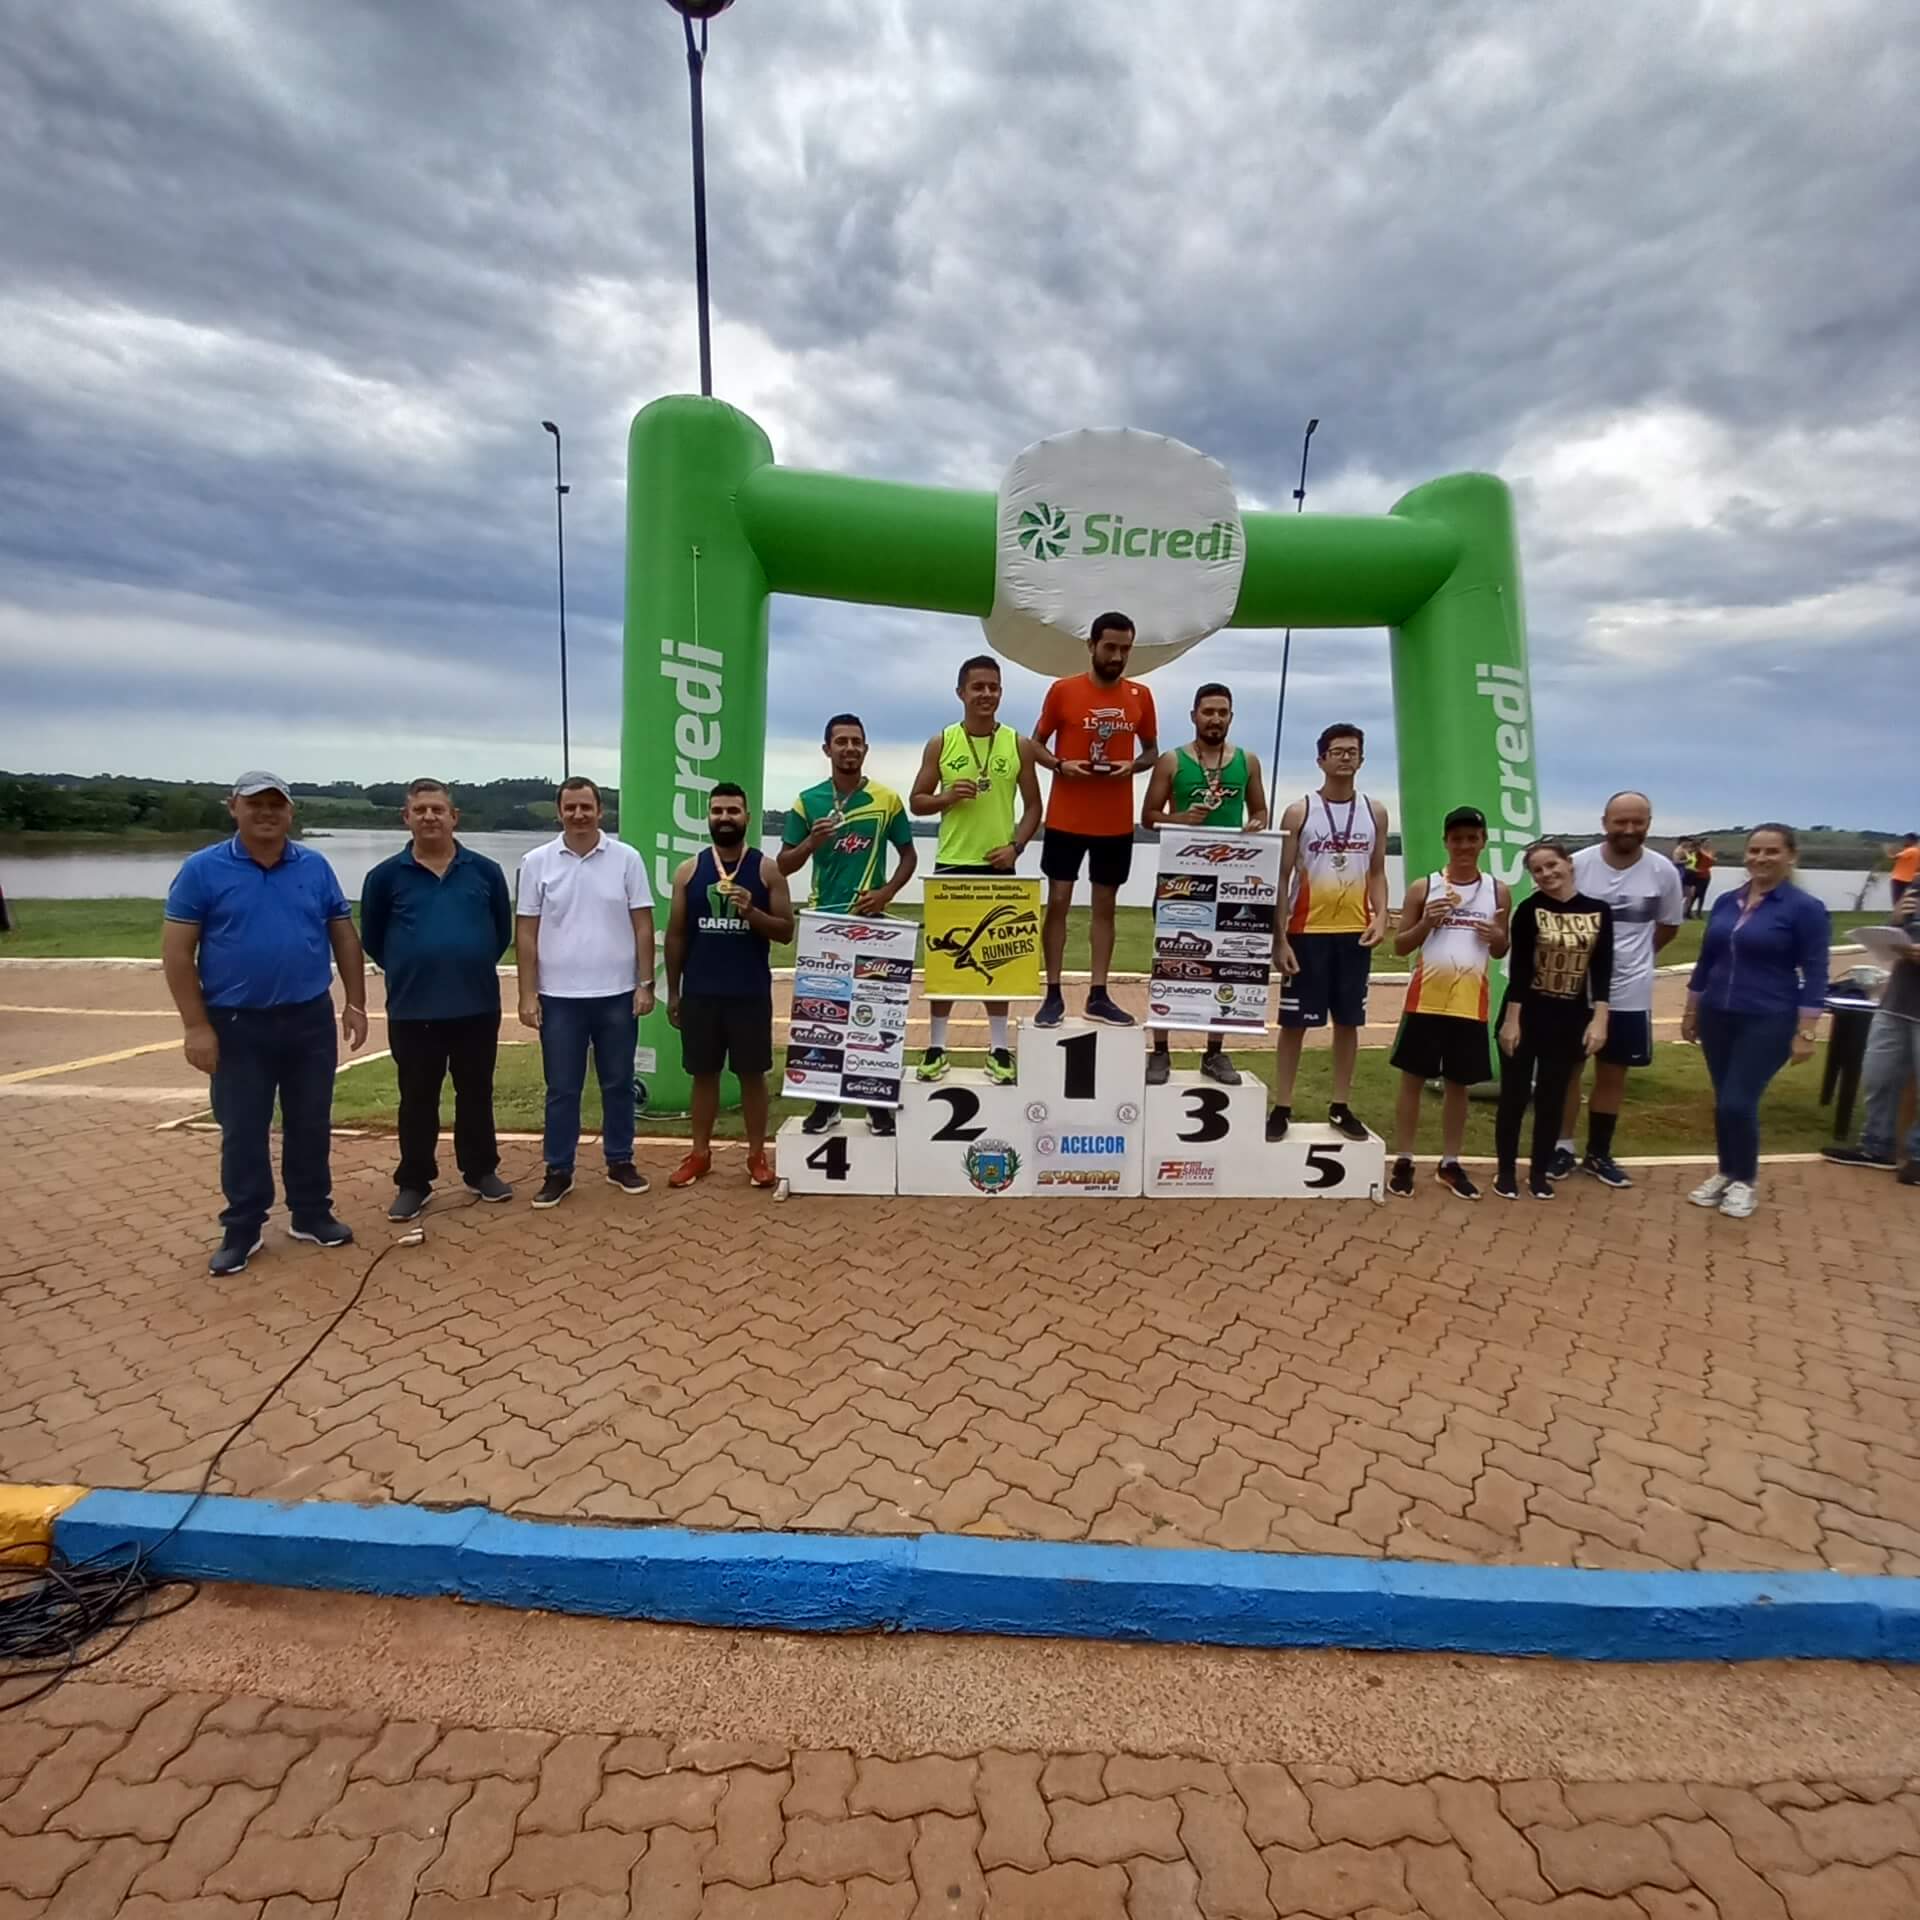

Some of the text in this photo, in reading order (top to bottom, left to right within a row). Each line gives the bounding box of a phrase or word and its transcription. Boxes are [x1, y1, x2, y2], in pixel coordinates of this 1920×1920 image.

[1082, 514, 1234, 560] Sicredi
[1082, 717, 1098, 730] 15
[656, 638, 724, 899] icredi
[1165, 880, 1214, 893] SulCar
[1219, 882, 1275, 897] Sandro
[698, 917, 750, 930] CARRA
[987, 923, 1039, 940] FORMA
[981, 938, 1035, 961] RUNNERS
[797, 956, 851, 972] Sandro
[864, 960, 911, 976] SulCar
[1056, 1031, 1098, 1099] 1
[928, 1087, 987, 1142] 2
[1176, 1087, 1230, 1142] 3
[1060, 1135, 1125, 1154] ACELCOR
[806, 1136, 851, 1180] 4
[1303, 1143, 1346, 1188] 5
